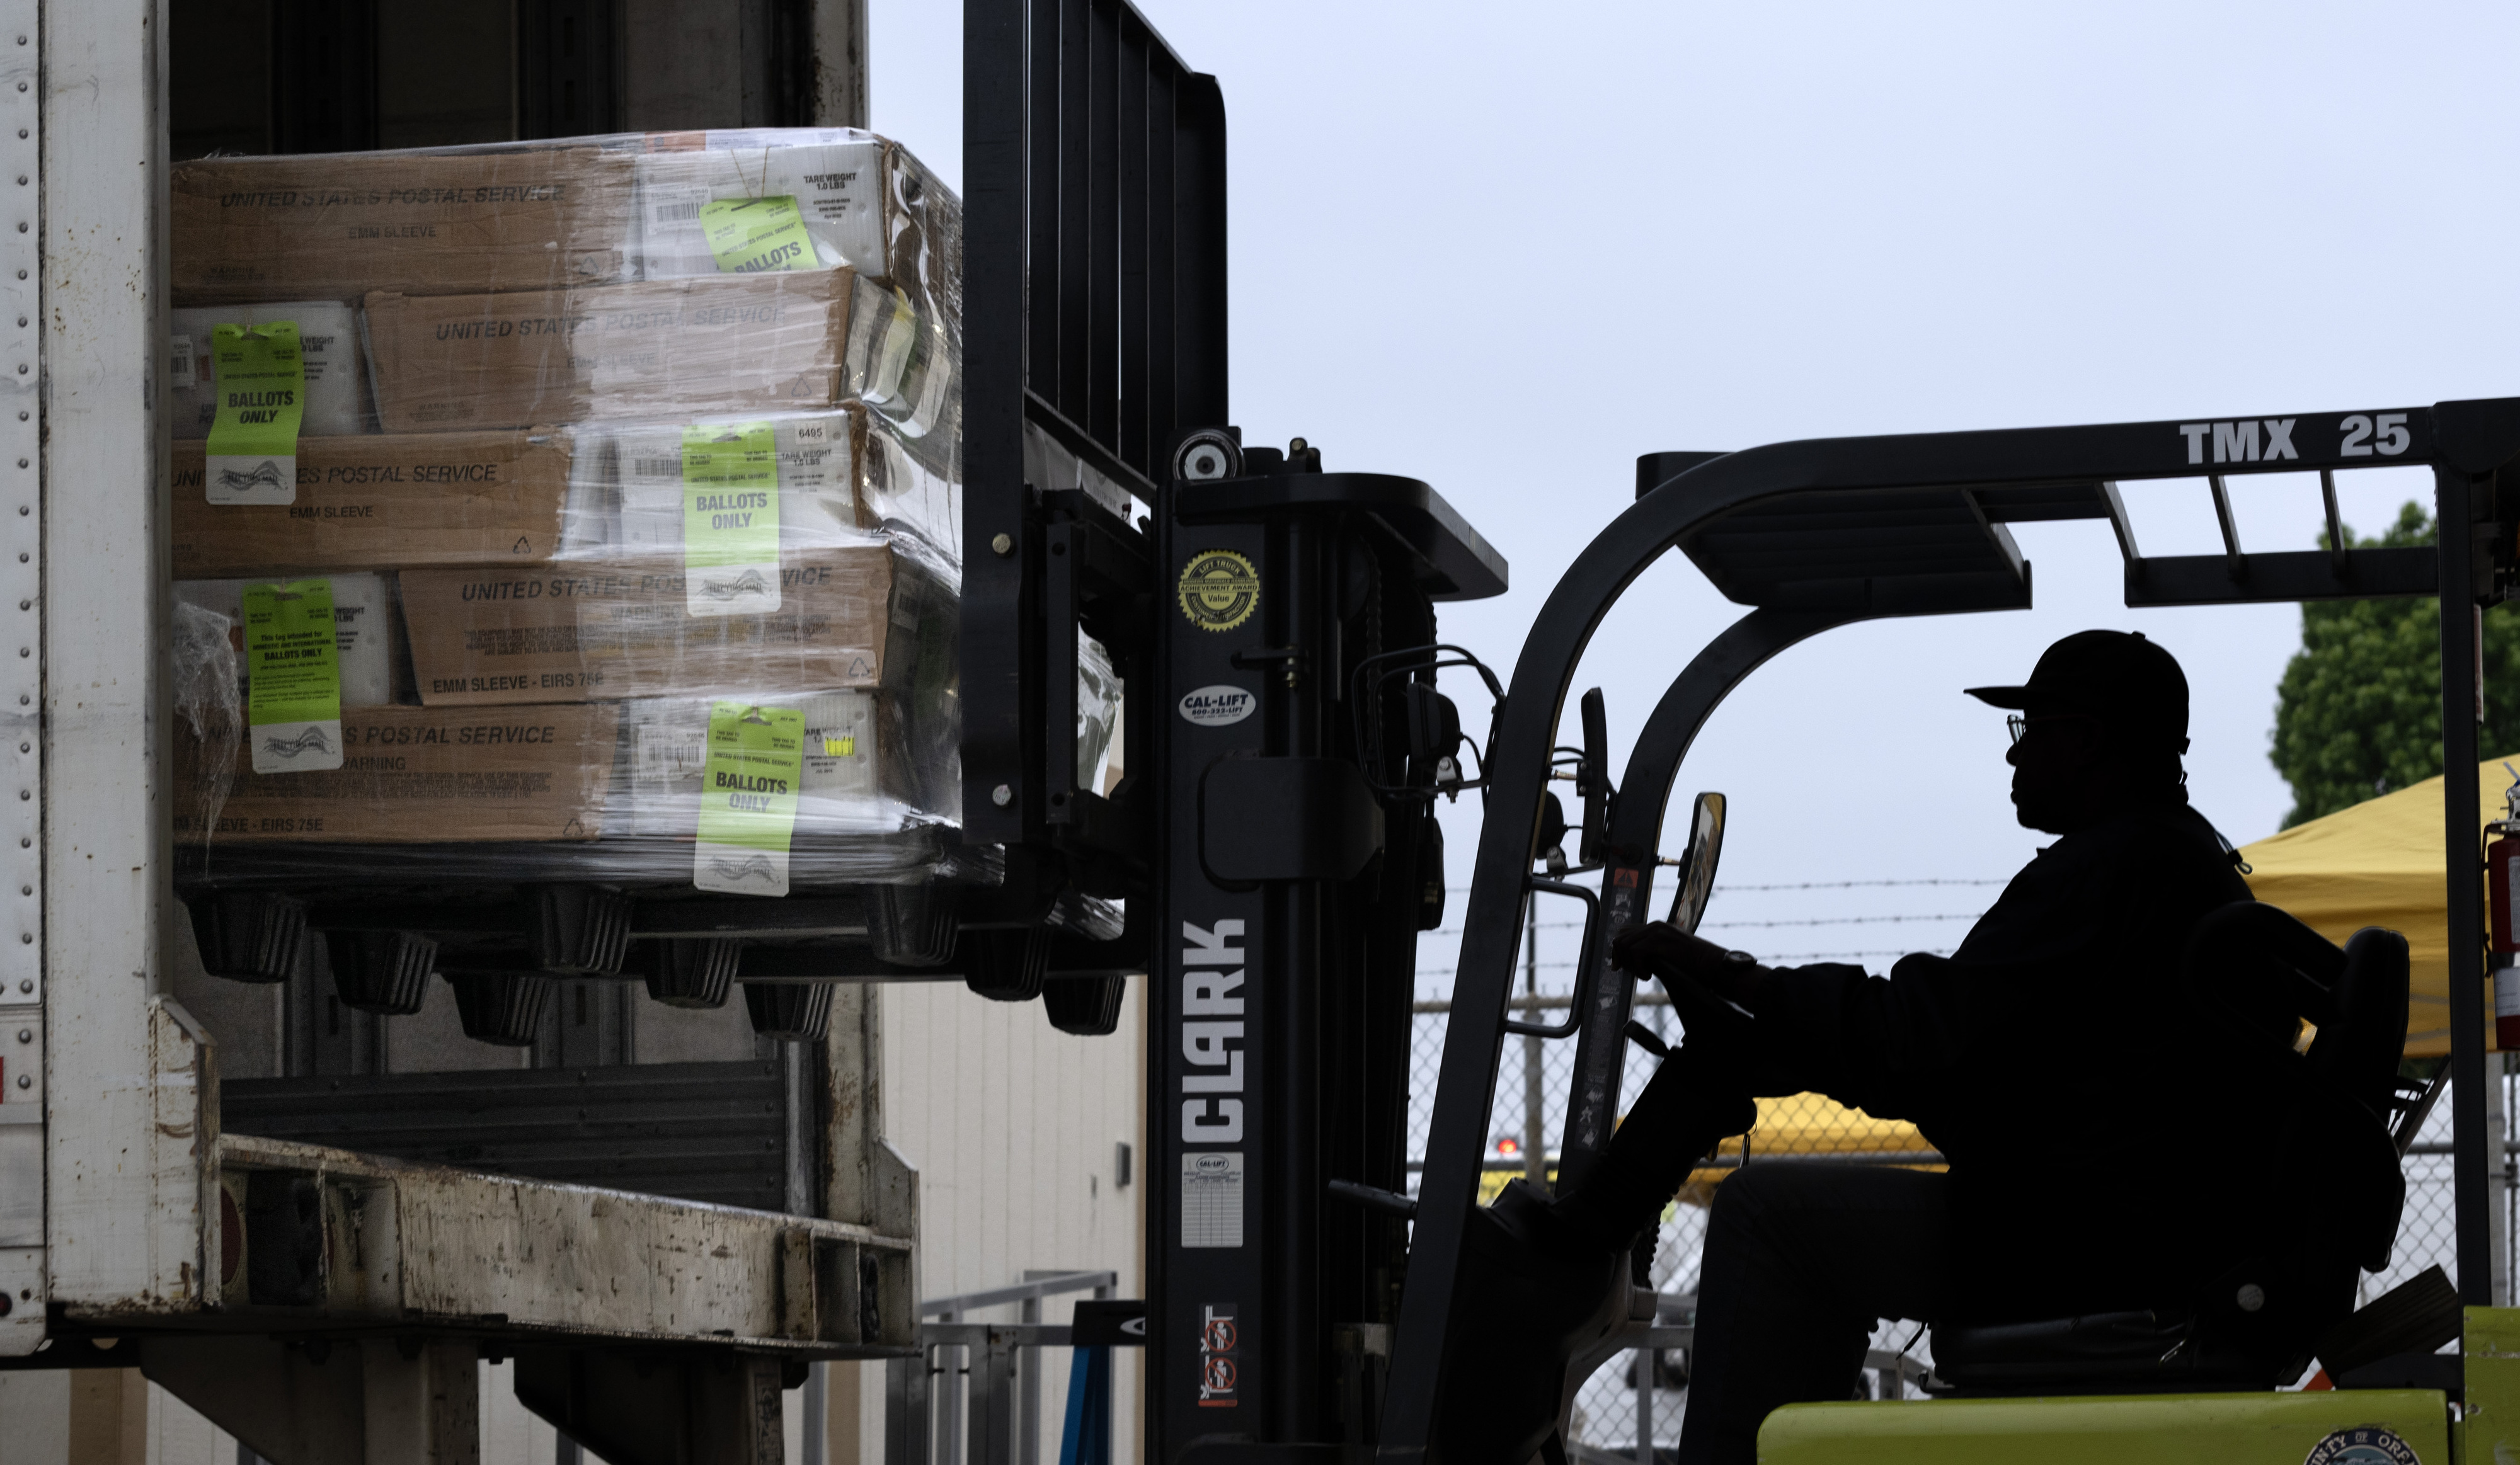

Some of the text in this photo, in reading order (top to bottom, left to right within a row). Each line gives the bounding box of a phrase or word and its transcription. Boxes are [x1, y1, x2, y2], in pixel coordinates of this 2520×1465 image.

[804, 173, 857, 183] TARE WEIGHT
[829, 181, 845, 190] LBS
[220, 184, 566, 208] UNITED STATES POSTAL SERVICE
[348, 225, 437, 239] EMM SLEEVE
[722, 223, 794, 256] UNITED STATES POSTAL SERVICE
[735, 242, 802, 273] BALLOTS
[436, 319, 513, 341] UNITED
[305, 336, 334, 345] WEIGHT
[227, 390, 294, 408] BALLOTS
[239, 409, 278, 424] ONLY
[798, 428, 823, 438] 6495
[2180, 413, 2410, 465] TMX 25
[781, 449, 832, 460] TARE WEIGHT
[328, 465, 405, 484] POSTAL
[413, 464, 497, 483] SERVICE
[696, 493, 767, 512] BALLOTS
[290, 505, 374, 518] EMM SLEEVE
[712, 512, 752, 530] ONLY
[1198, 560, 1241, 574] LIFT TRUCK
[462, 566, 833, 601] UNITED STATES POS VICE
[1208, 594, 1230, 603] Value
[335, 607, 365, 615] WEIGHT
[264, 648, 322, 661] BALLOTS ONLY
[433, 679, 466, 693] EMM
[471, 675, 528, 692] SLEEVE
[541, 673, 575, 688] EIRS
[578, 672, 604, 687] 75E
[1184, 693, 1249, 709] CAL-LIFT
[1192, 706, 1243, 715] 800-322-LIFT
[366, 725, 556, 745] POSTAL SERVICE
[733, 754, 751, 762] STATES
[716, 772, 788, 794] BALLOTS
[729, 792, 770, 812] ONLY
[261, 818, 295, 832] EIRS
[299, 818, 323, 831] 75E
[1182, 918, 1245, 1143] CLARK
[2356, 1432, 2368, 1442] OF
